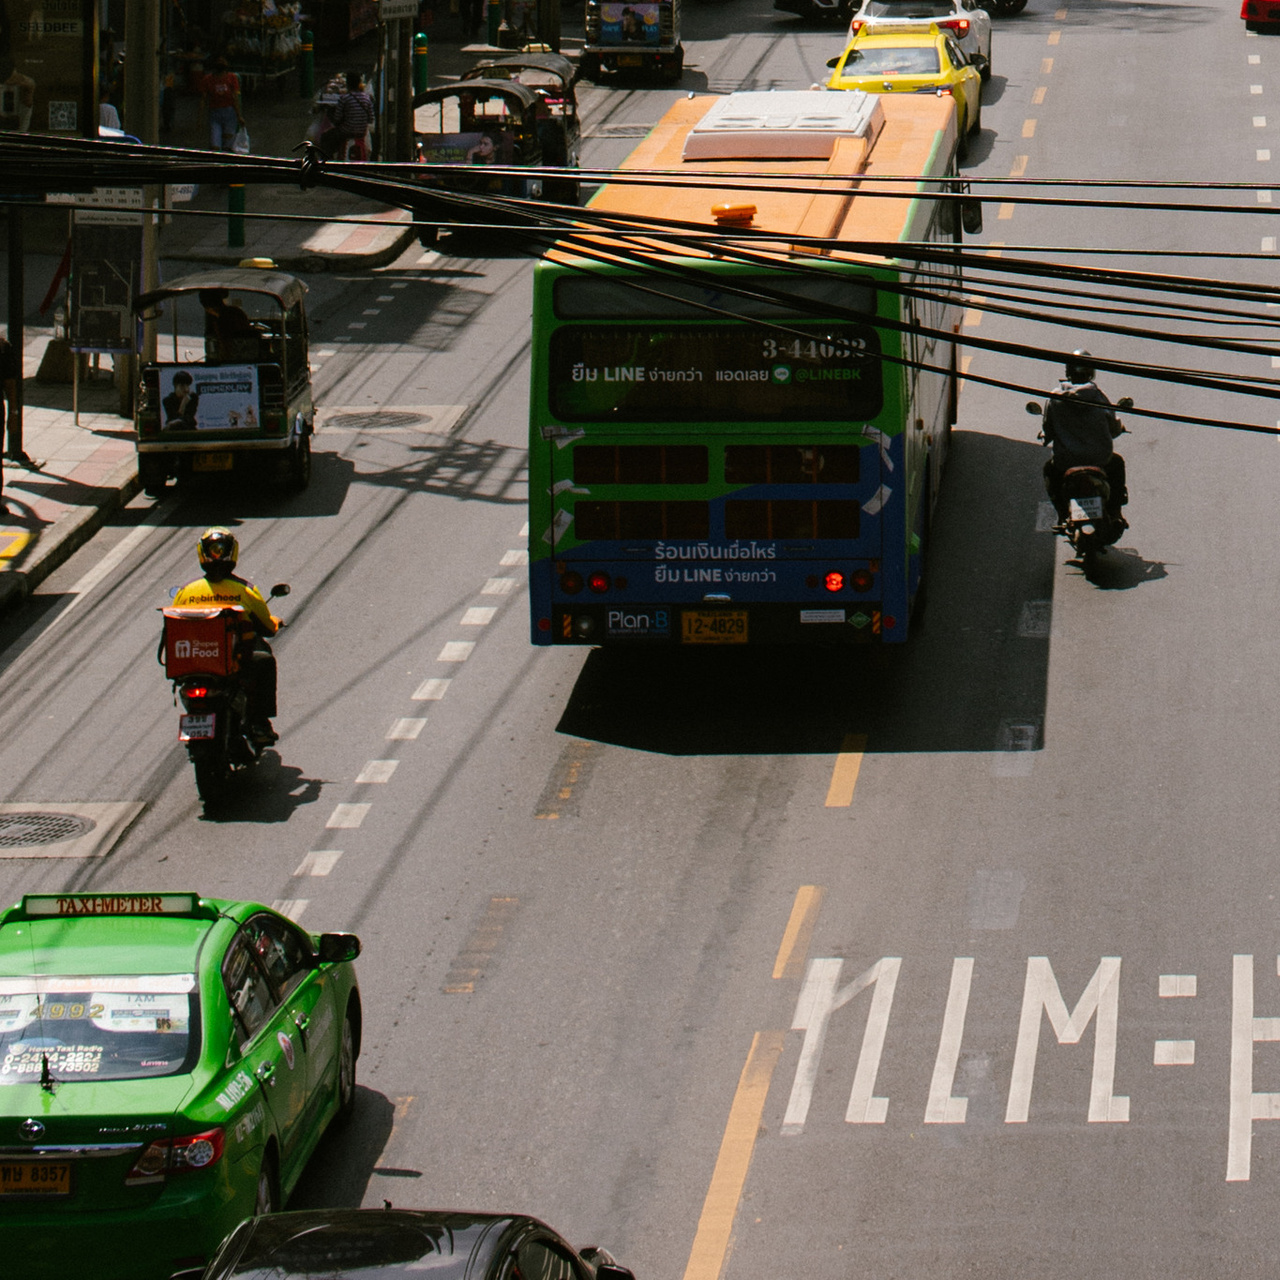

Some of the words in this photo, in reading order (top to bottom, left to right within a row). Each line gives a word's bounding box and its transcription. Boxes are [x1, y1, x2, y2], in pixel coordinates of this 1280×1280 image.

[571, 362, 598, 382] ยืม
[603, 366, 645, 381] LINE
[648, 368, 703, 382] ง่ายกว่า
[715, 368, 769, 382] แอดเลย
[795, 367, 862, 382] @LINEBK
[654, 539, 777, 560] ร้อนเงินเมื่อไหร่
[654, 565, 680, 583] ยืม
[683, 569, 723, 582] LINE
[724, 569, 777, 583] ง่ายกว่า
[687, 617, 744, 635] 12-4829
[192, 648, 219, 658] Food
[56, 896, 163, 914] TAXI-METER
[29, 1003, 105, 1019] 4992
[156, 1018, 172, 1029] GPS
[31, 1166, 67, 1183] 8357
